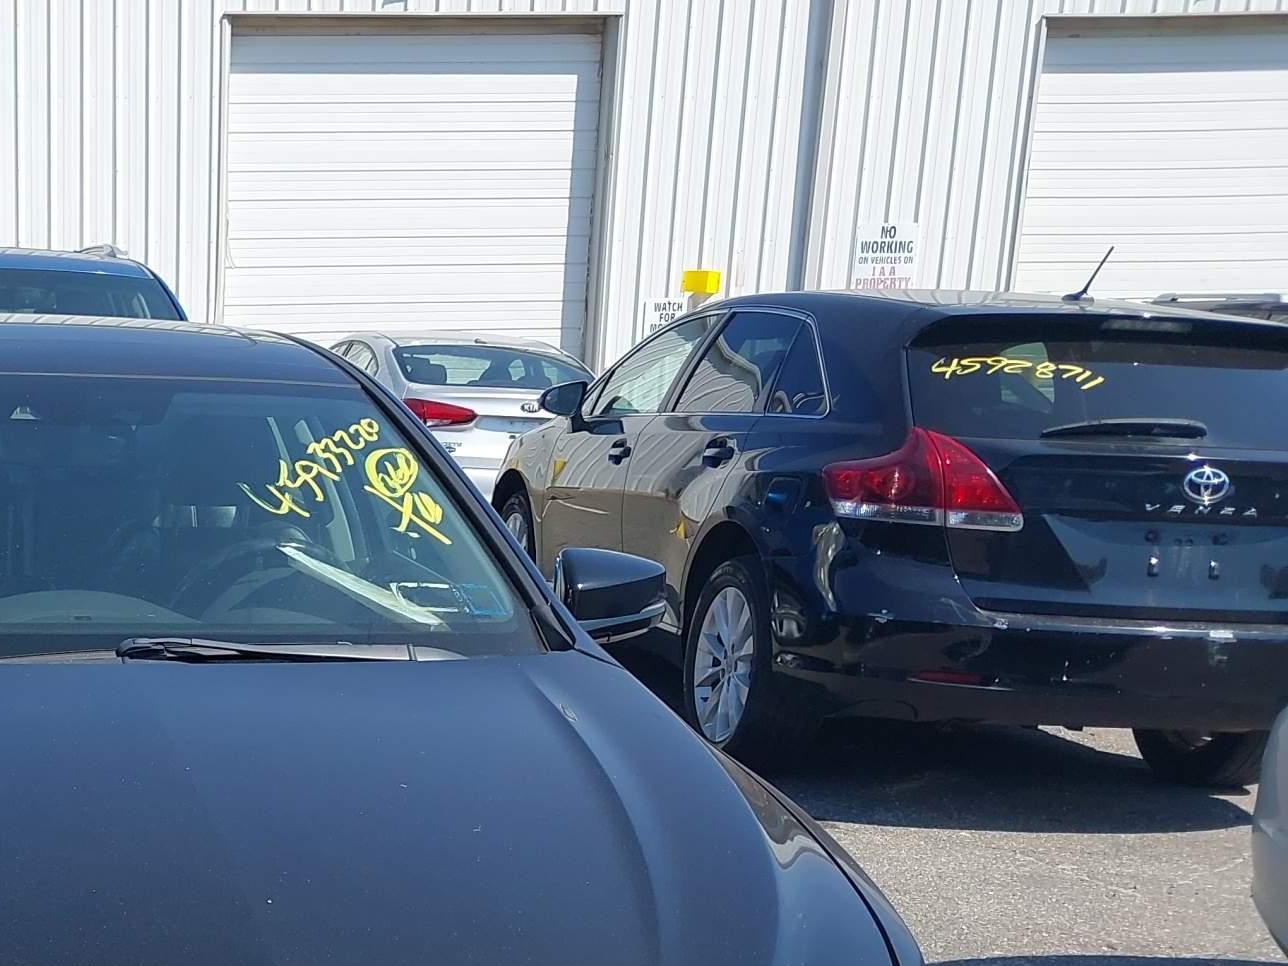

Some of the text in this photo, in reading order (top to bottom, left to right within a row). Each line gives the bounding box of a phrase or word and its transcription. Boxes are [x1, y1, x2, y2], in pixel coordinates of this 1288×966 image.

[880, 225, 897, 240] NO
[860, 240, 914, 254] WORKING
[858, 255, 914, 265] ON VEHICLES ON
[855, 277, 911, 290] PROPERTY
[653, 301, 684, 313] WATCH
[658, 312, 676, 323] FOR
[930, 356, 1105, 390] 45928711
[523, 403, 540, 413] KIA
[236, 417, 380, 518] 45933220
[1144, 503, 1258, 517] VENZA
